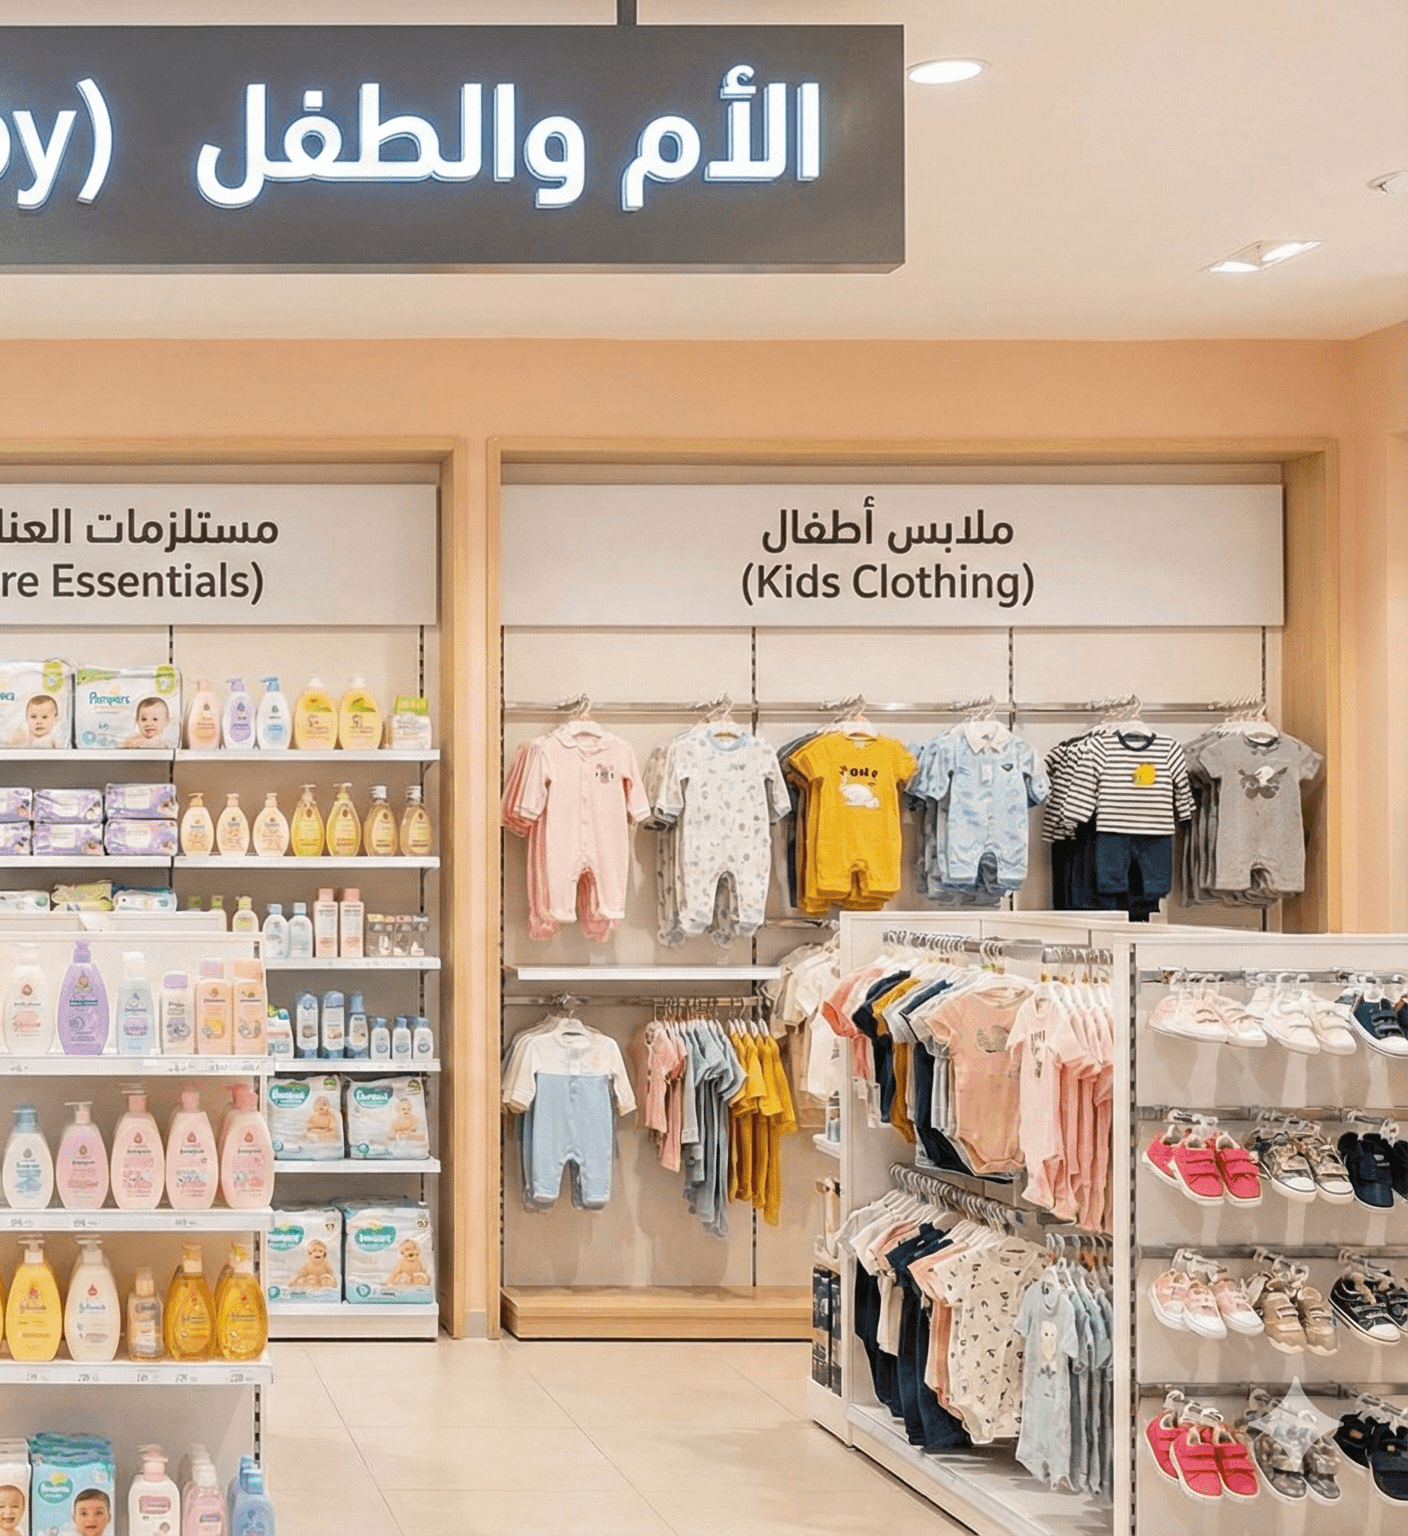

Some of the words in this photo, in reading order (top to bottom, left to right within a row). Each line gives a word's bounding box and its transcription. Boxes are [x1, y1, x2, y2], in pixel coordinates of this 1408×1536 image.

[196, 83, 585, 208] والطفل
[621, 65, 820, 210] الأم
[86, 508, 279, 553] مستلزمات
[762, 495, 875, 553] أطفال
[887, 509, 1014, 554] ملابس
[52, 561, 263, 606] Essentials)
[742, 562, 841, 606] (Kids
[852, 562, 1034, 608] Clothing)
